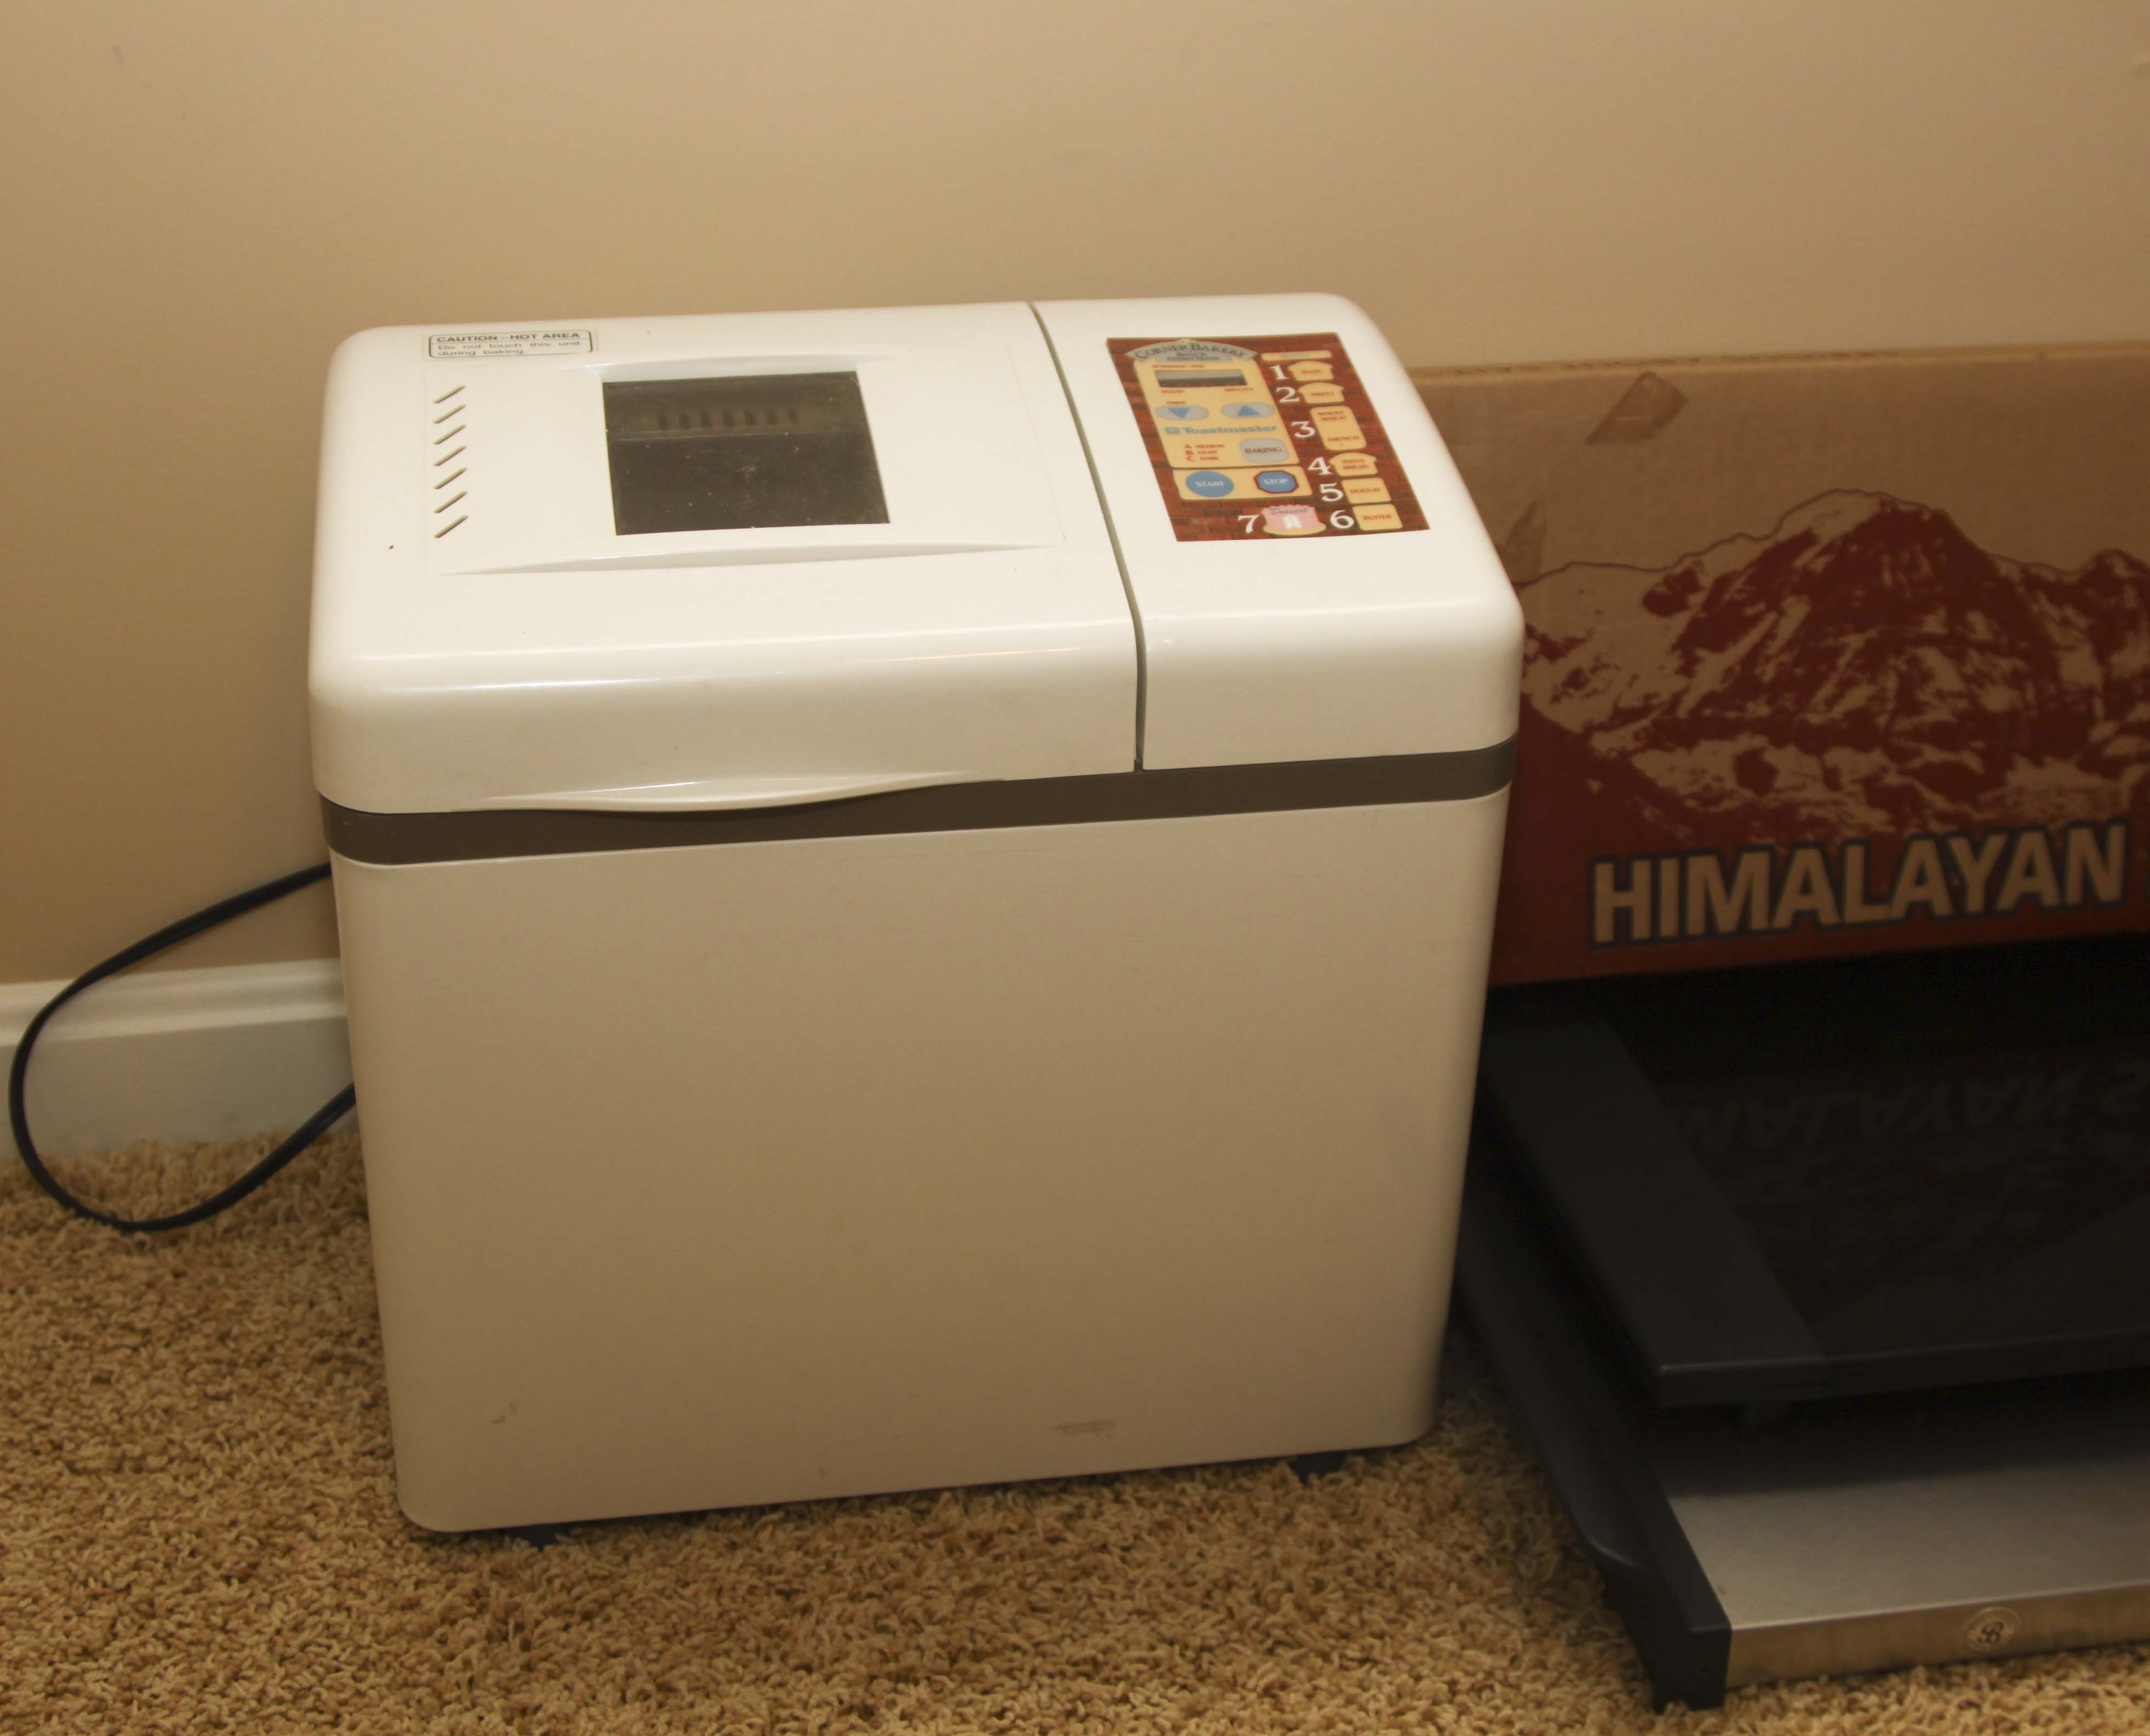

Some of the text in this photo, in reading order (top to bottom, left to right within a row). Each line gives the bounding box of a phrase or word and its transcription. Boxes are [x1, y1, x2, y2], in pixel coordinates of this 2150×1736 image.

[1191, 343, 1246, 357] BAKERY
[1270, 364, 1289, 380] 1
[1276, 386, 1300, 403] 2
[1182, 425, 1278, 434] Toastmaster
[1291, 420, 1316, 438] 3
[1307, 456, 1333, 475] 4
[1319, 482, 1344, 501] 5
[1237, 514, 1260, 534] 7
[1330, 510, 1354, 529] 6
[1589, 821, 2129, 947] HIMALAYAN
